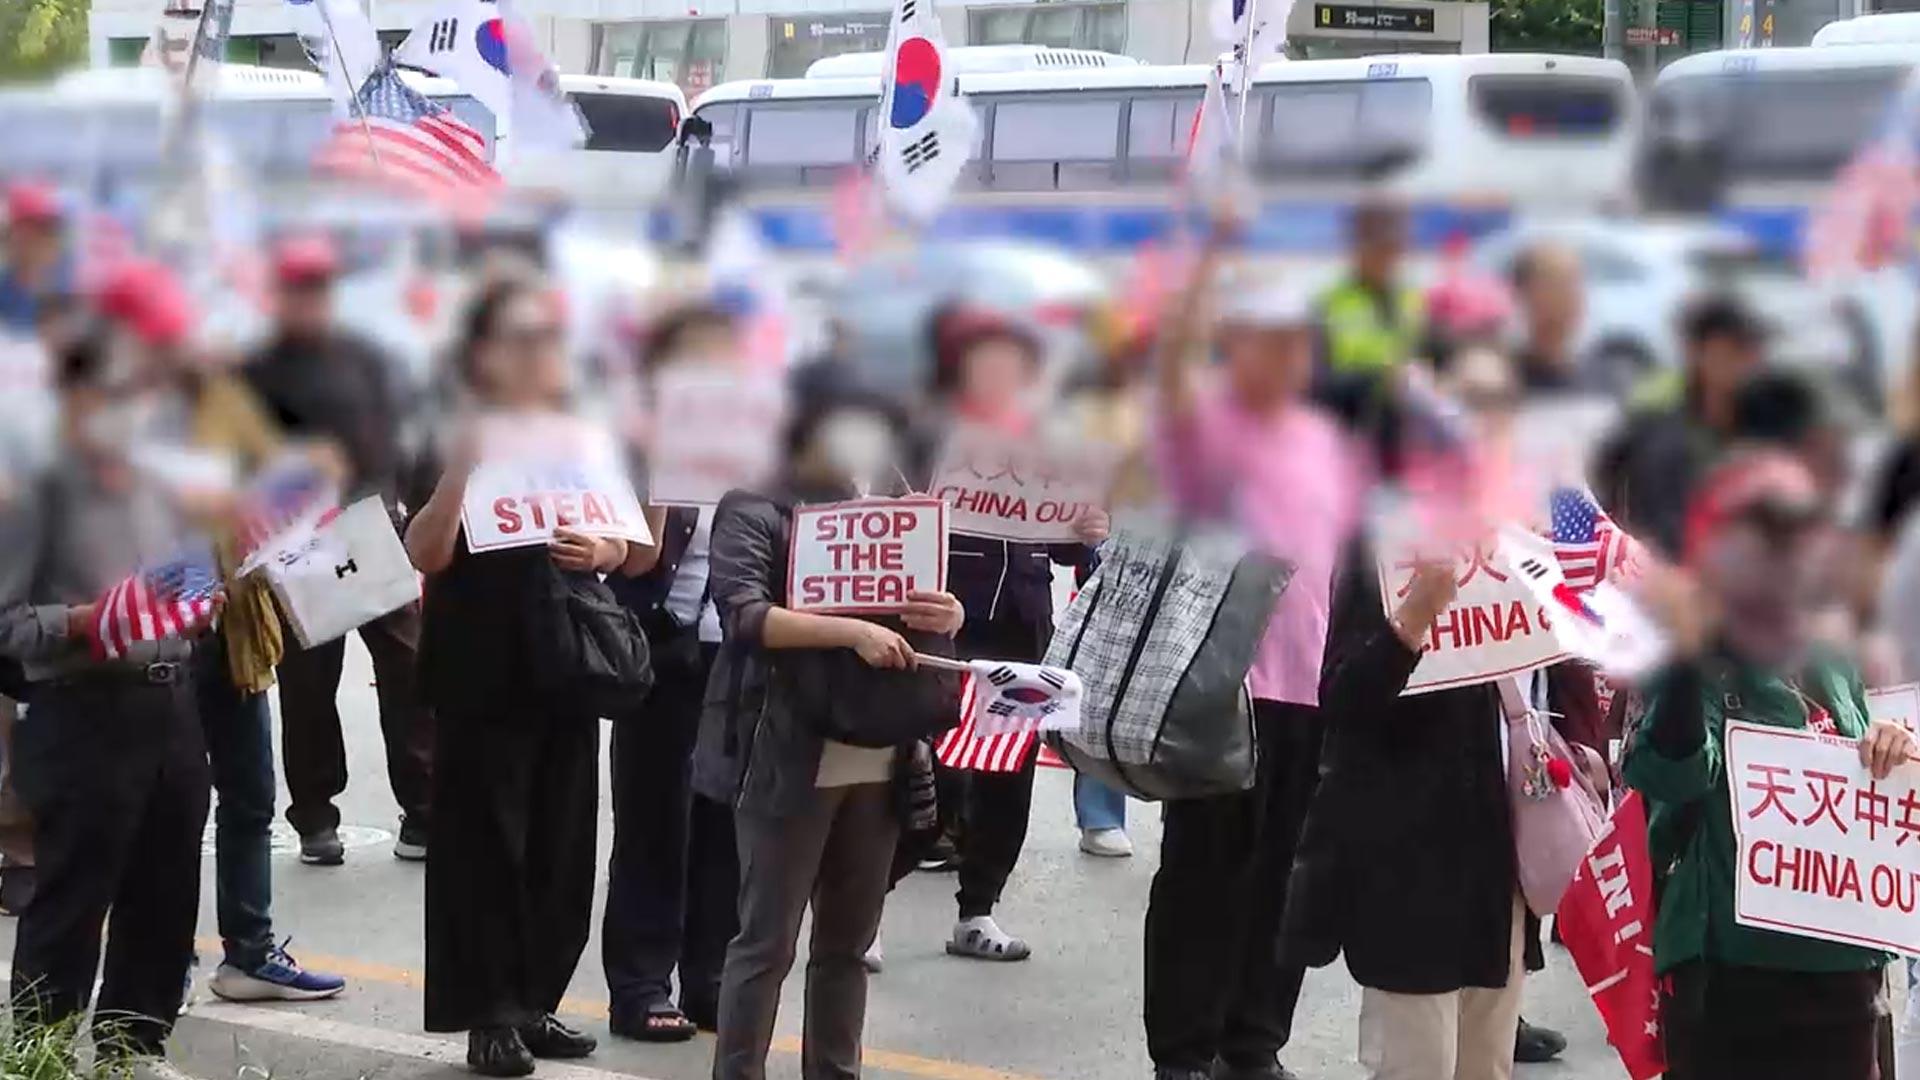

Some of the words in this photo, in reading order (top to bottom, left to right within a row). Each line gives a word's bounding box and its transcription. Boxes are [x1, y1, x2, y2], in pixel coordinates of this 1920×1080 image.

[493, 490, 627, 534] STEAL
[815, 511, 917, 541] STOP
[826, 543, 904, 571] THE
[1420, 600, 1531, 653] HINA
[1747, 763, 1920, 847] 天灭中共
[1748, 840, 1863, 903] CHINA
[1871, 864, 1920, 913] OU
